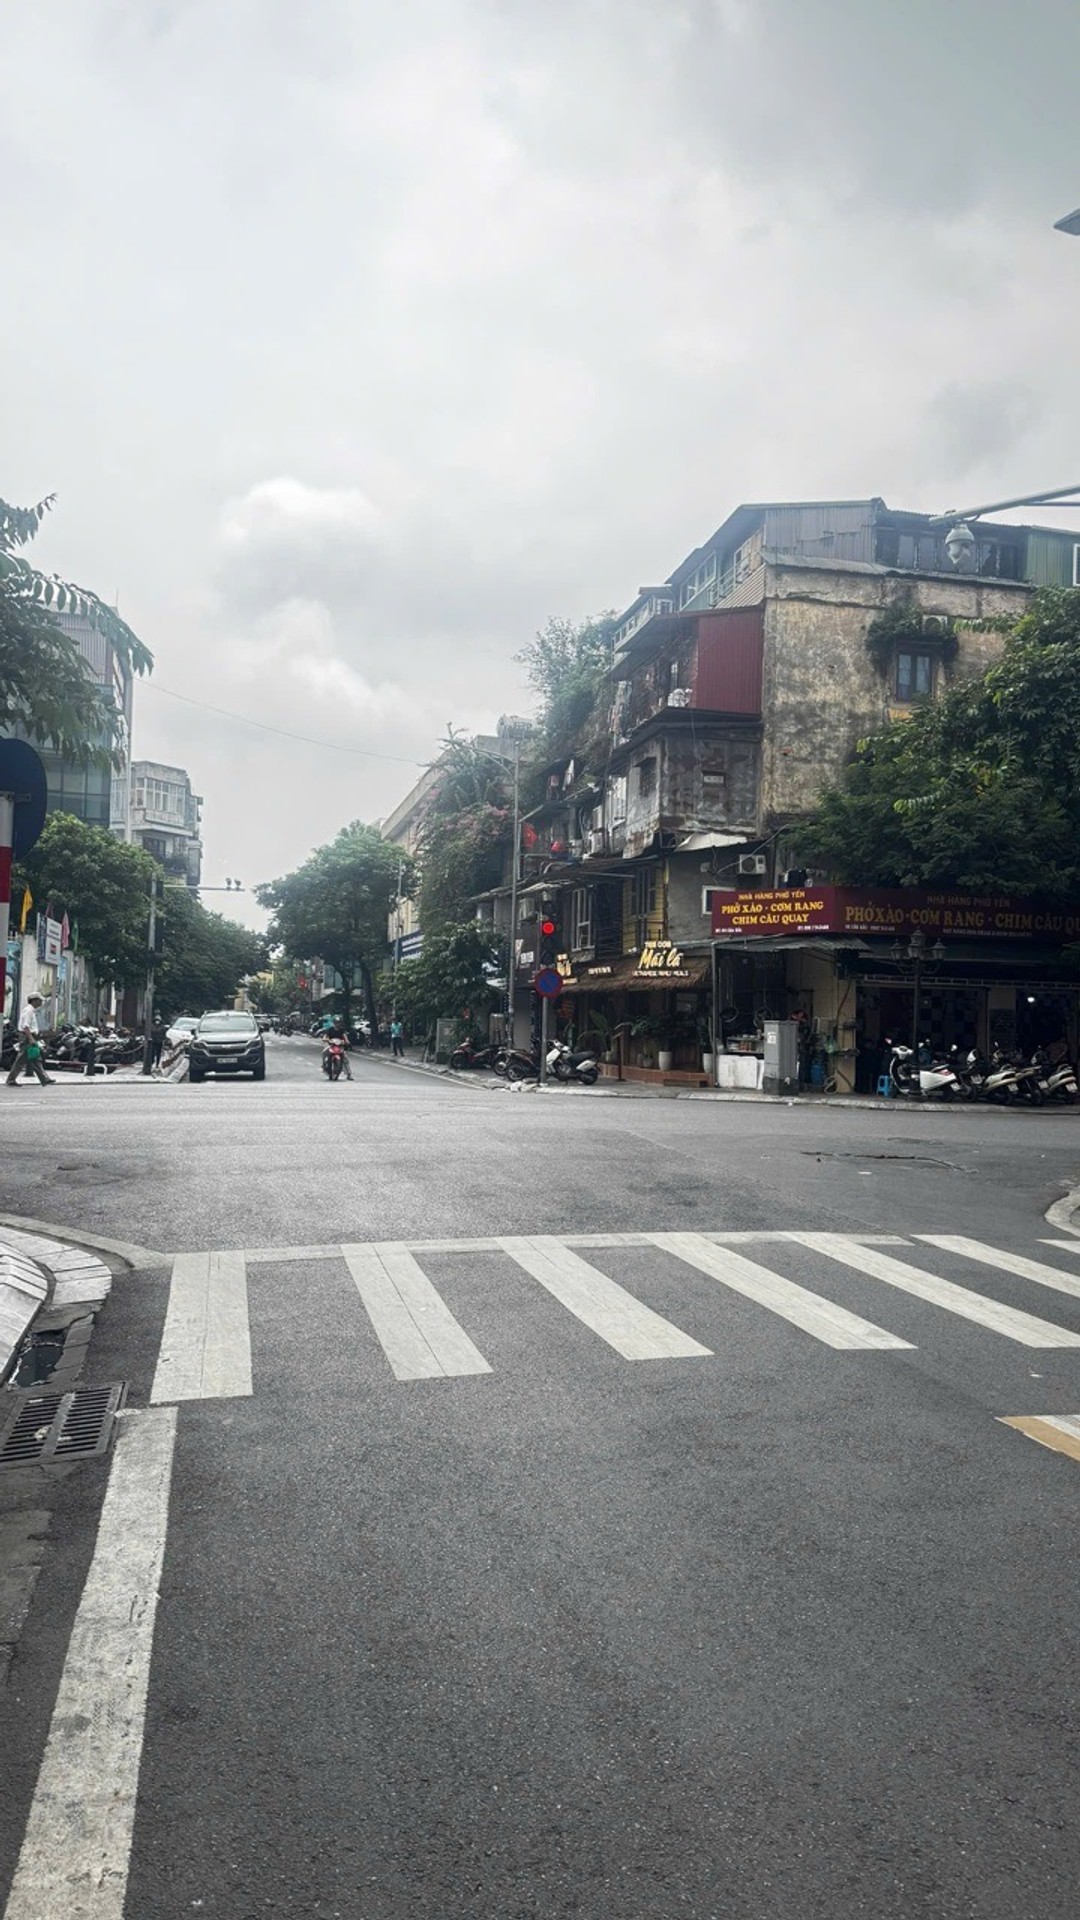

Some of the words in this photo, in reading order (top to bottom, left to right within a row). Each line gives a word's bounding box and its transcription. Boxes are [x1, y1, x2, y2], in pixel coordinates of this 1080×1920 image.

[722, 902, 740, 914] PHỞ
[742, 902, 762, 913] XÀO
[770, 901, 792, 912] CƠM
[795, 901, 823, 911] RANG
[733, 916, 757, 925] CHIM
[781, 913, 810, 925] QUAY
[845, 901, 875, 921] PHỞ
[874, 903, 903, 923] XÀO
[910, 906, 940, 926] CƠM
[942, 909, 985, 928] RANG
[994, 911, 1032, 930] CHIM
